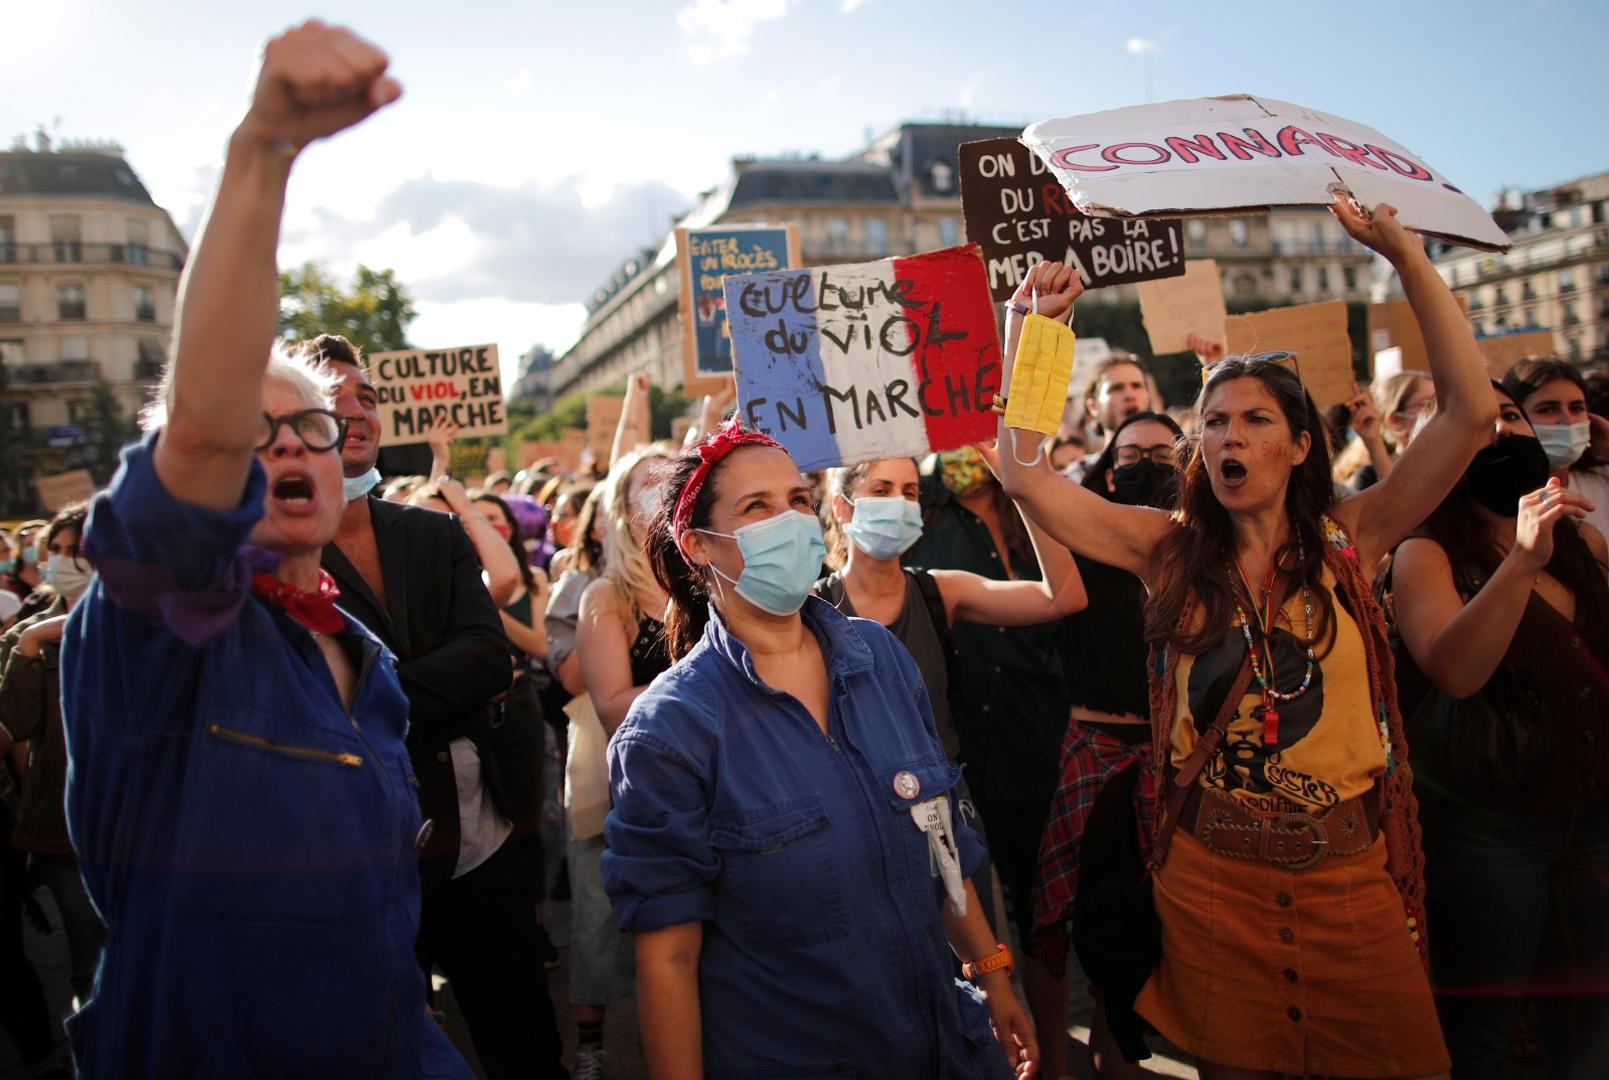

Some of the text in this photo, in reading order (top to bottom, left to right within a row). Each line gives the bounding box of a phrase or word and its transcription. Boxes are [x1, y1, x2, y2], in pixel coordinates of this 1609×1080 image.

[978, 154, 1015, 178] ON
[1001, 188, 1034, 214] DU
[992, 218, 1149, 245] C'EST PAS LA
[378, 346, 494, 381] CULTURE
[377, 386, 405, 405] DU
[745, 356, 997, 435] EN MARCHE
